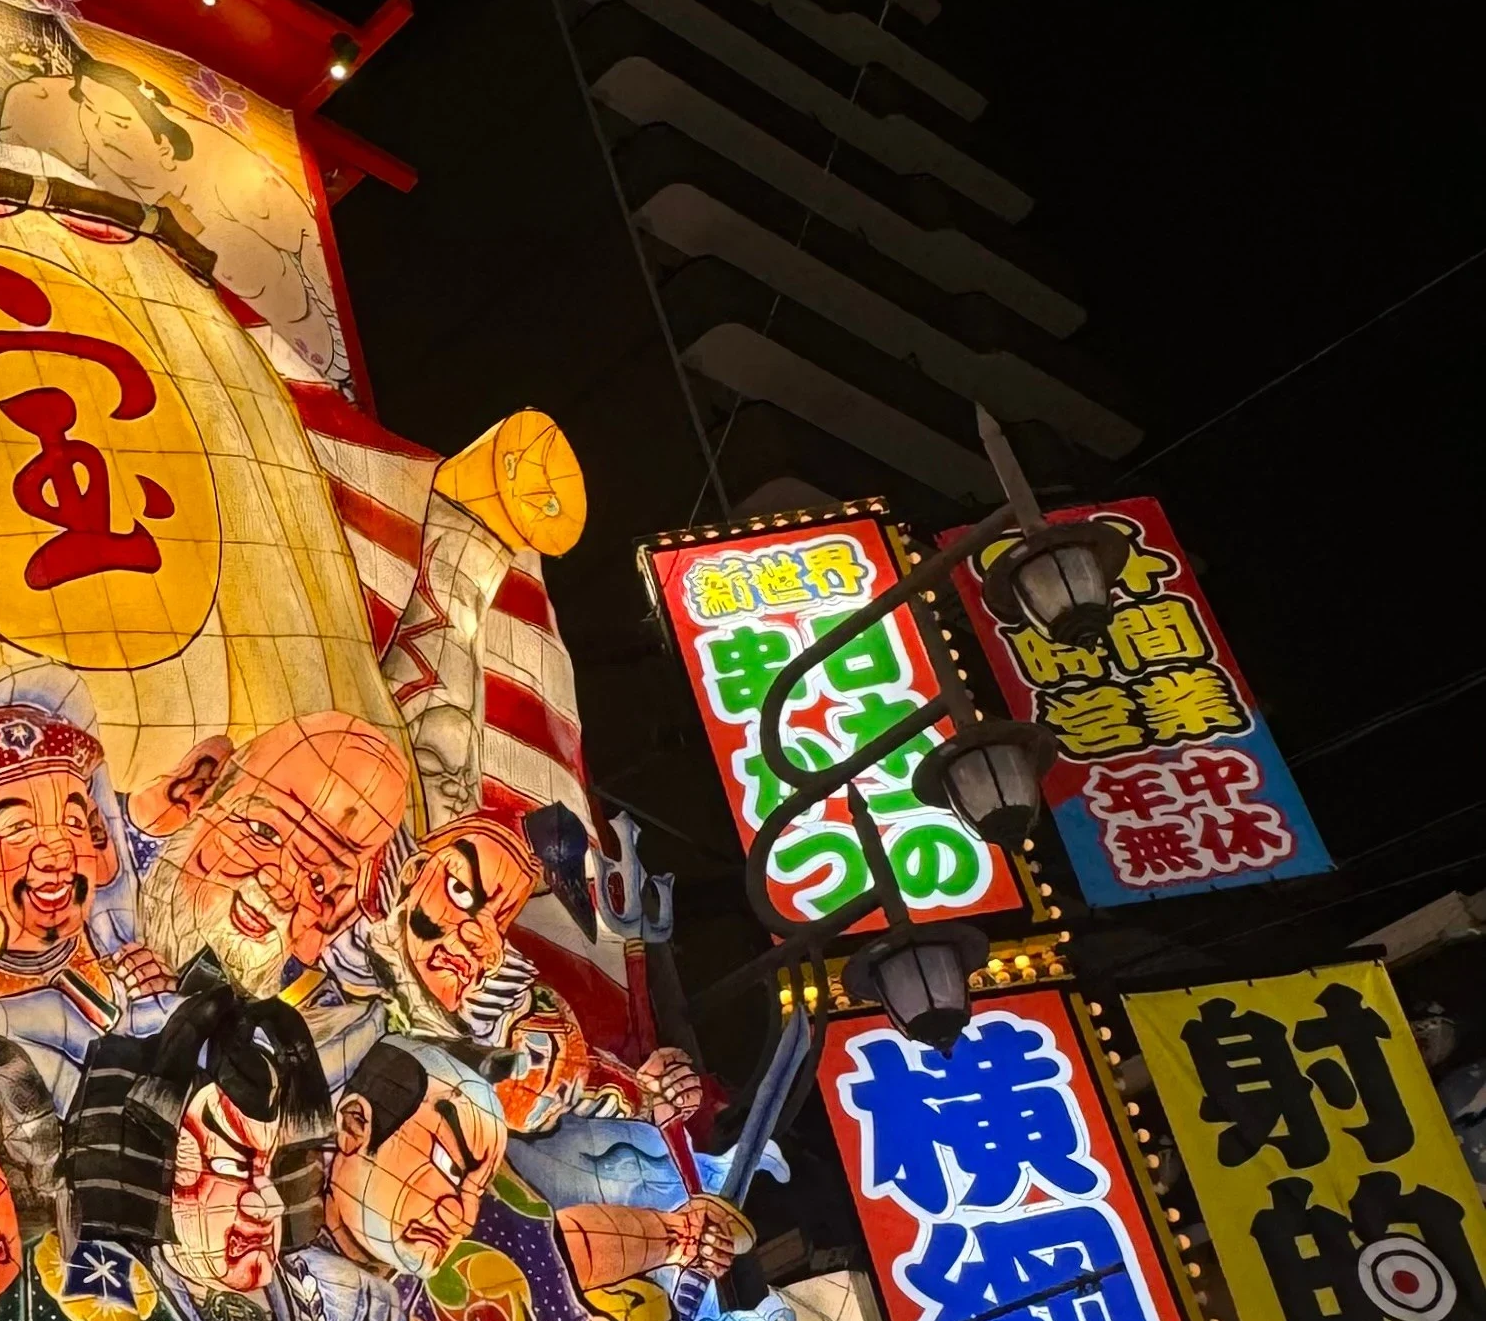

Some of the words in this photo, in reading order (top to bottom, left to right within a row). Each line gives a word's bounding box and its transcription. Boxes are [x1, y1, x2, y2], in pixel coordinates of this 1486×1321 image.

[694, 543, 868, 617] 新世界
[1045, 667, 1243, 753] 営業
[1093, 757, 1250, 821] 年中
[1113, 806, 1285, 877] 無休
